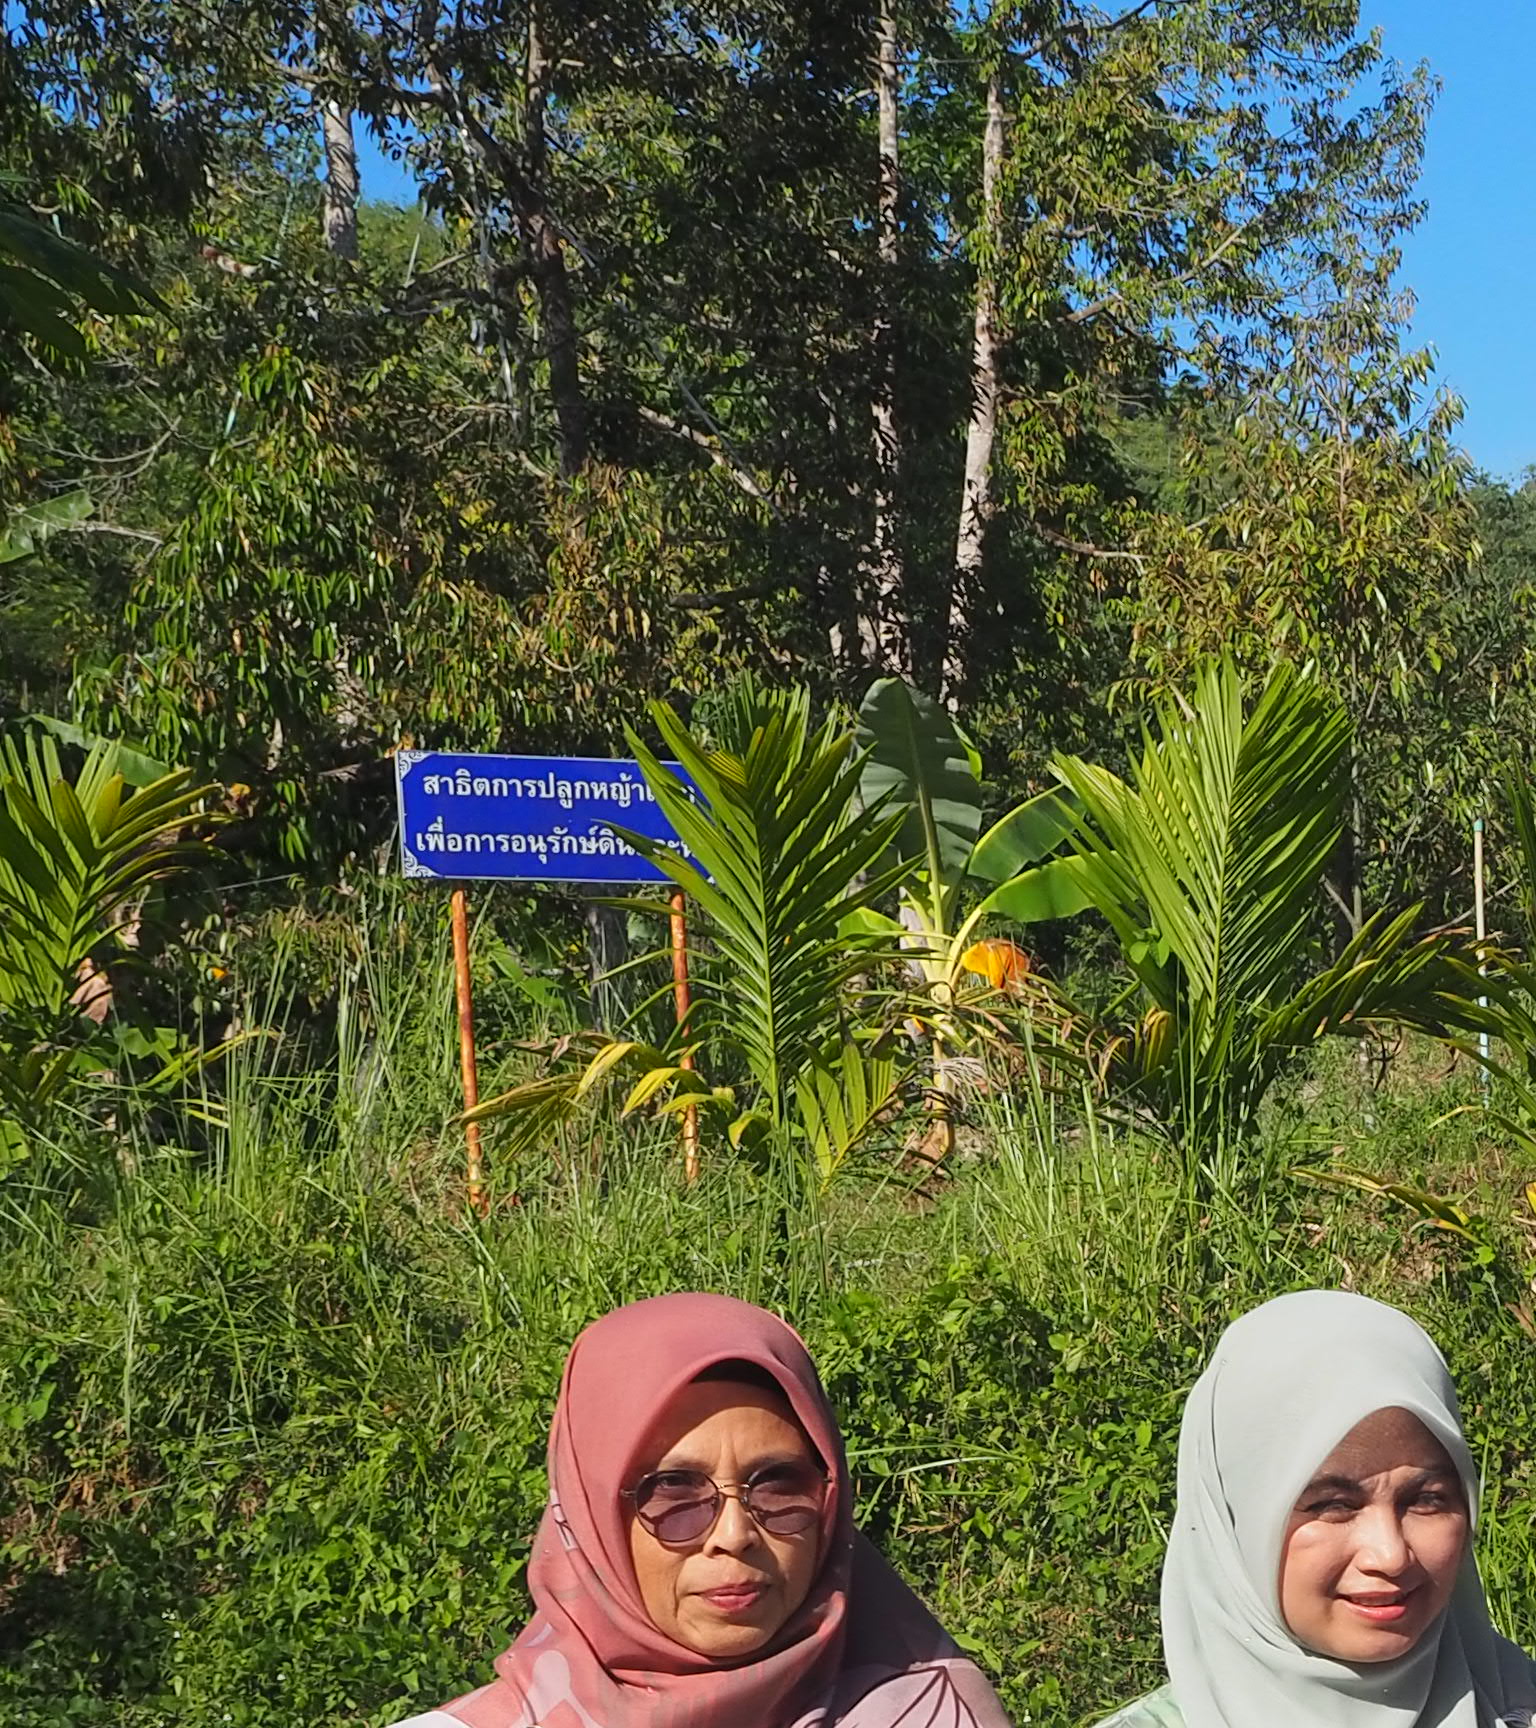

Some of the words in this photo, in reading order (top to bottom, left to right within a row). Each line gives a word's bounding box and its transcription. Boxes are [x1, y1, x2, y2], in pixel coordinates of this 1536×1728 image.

[422, 768, 695, 809] สาธิตการปลูกหญ้า
